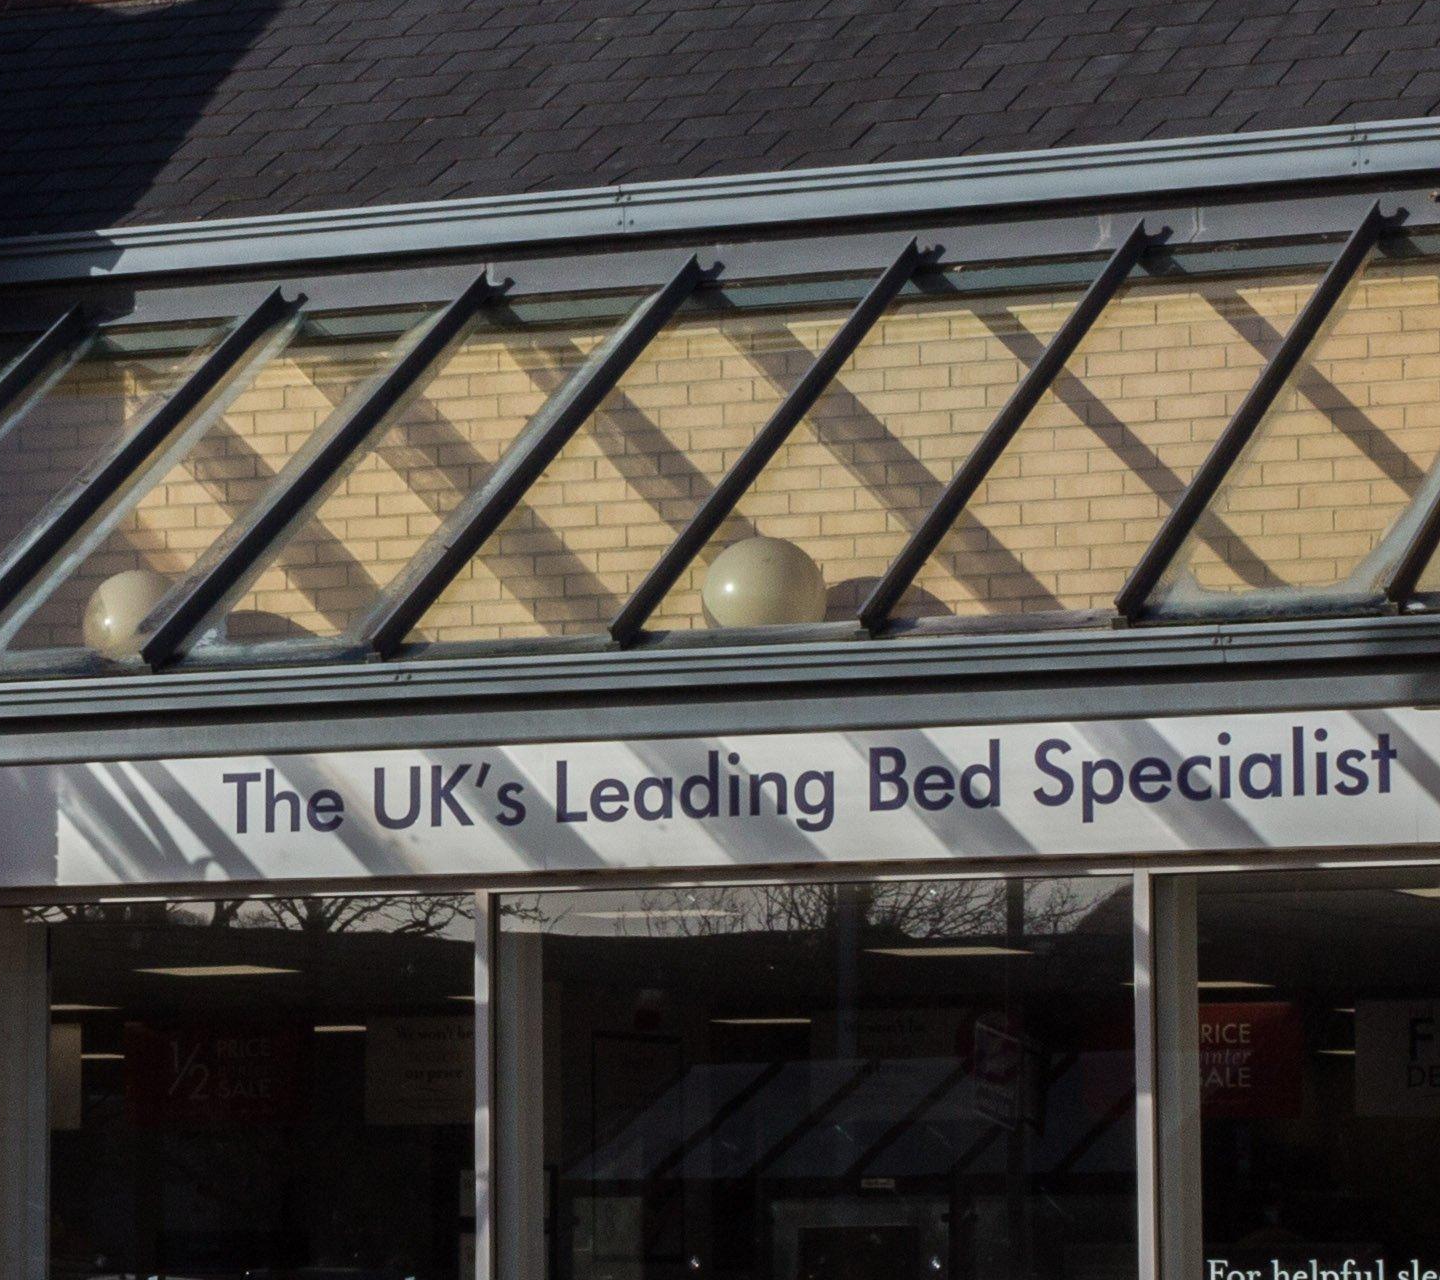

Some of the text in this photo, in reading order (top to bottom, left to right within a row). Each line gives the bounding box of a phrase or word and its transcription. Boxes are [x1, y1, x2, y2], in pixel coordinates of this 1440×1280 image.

[223, 725, 1399, 835] The UK's Leading Bed Specialist
[1200, 1022, 1251, 1044] RICE
[216, 1038, 271, 1058] PRICE
[217, 1079, 272, 1099] SALE
